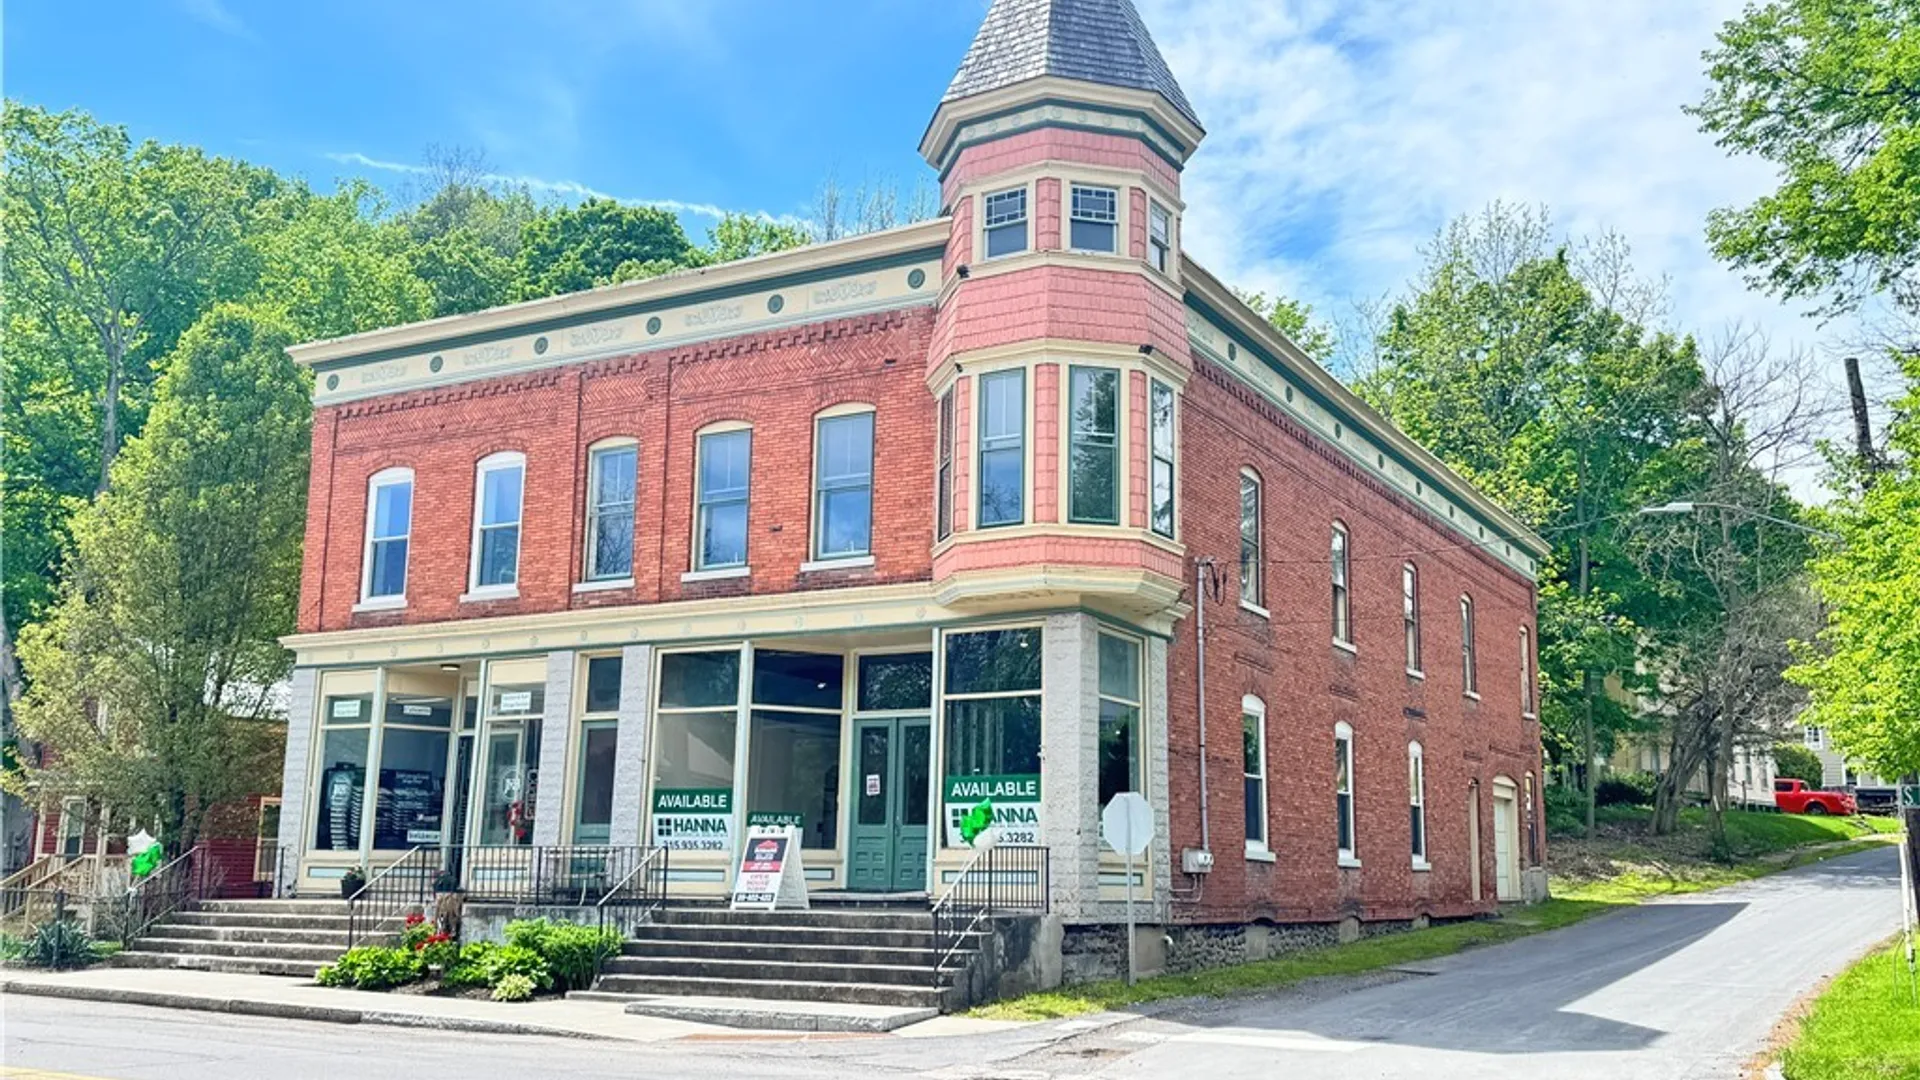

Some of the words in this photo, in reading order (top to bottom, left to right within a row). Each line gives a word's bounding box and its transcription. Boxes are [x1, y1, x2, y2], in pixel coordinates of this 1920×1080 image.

[951, 780, 1037, 797] AVAILABLE
[657, 794, 728, 808] AVAILABLE
[750, 813, 801, 825] AVAILABLE
[991, 807, 1039, 823] NNA
[673, 818, 728, 833] HANNA
